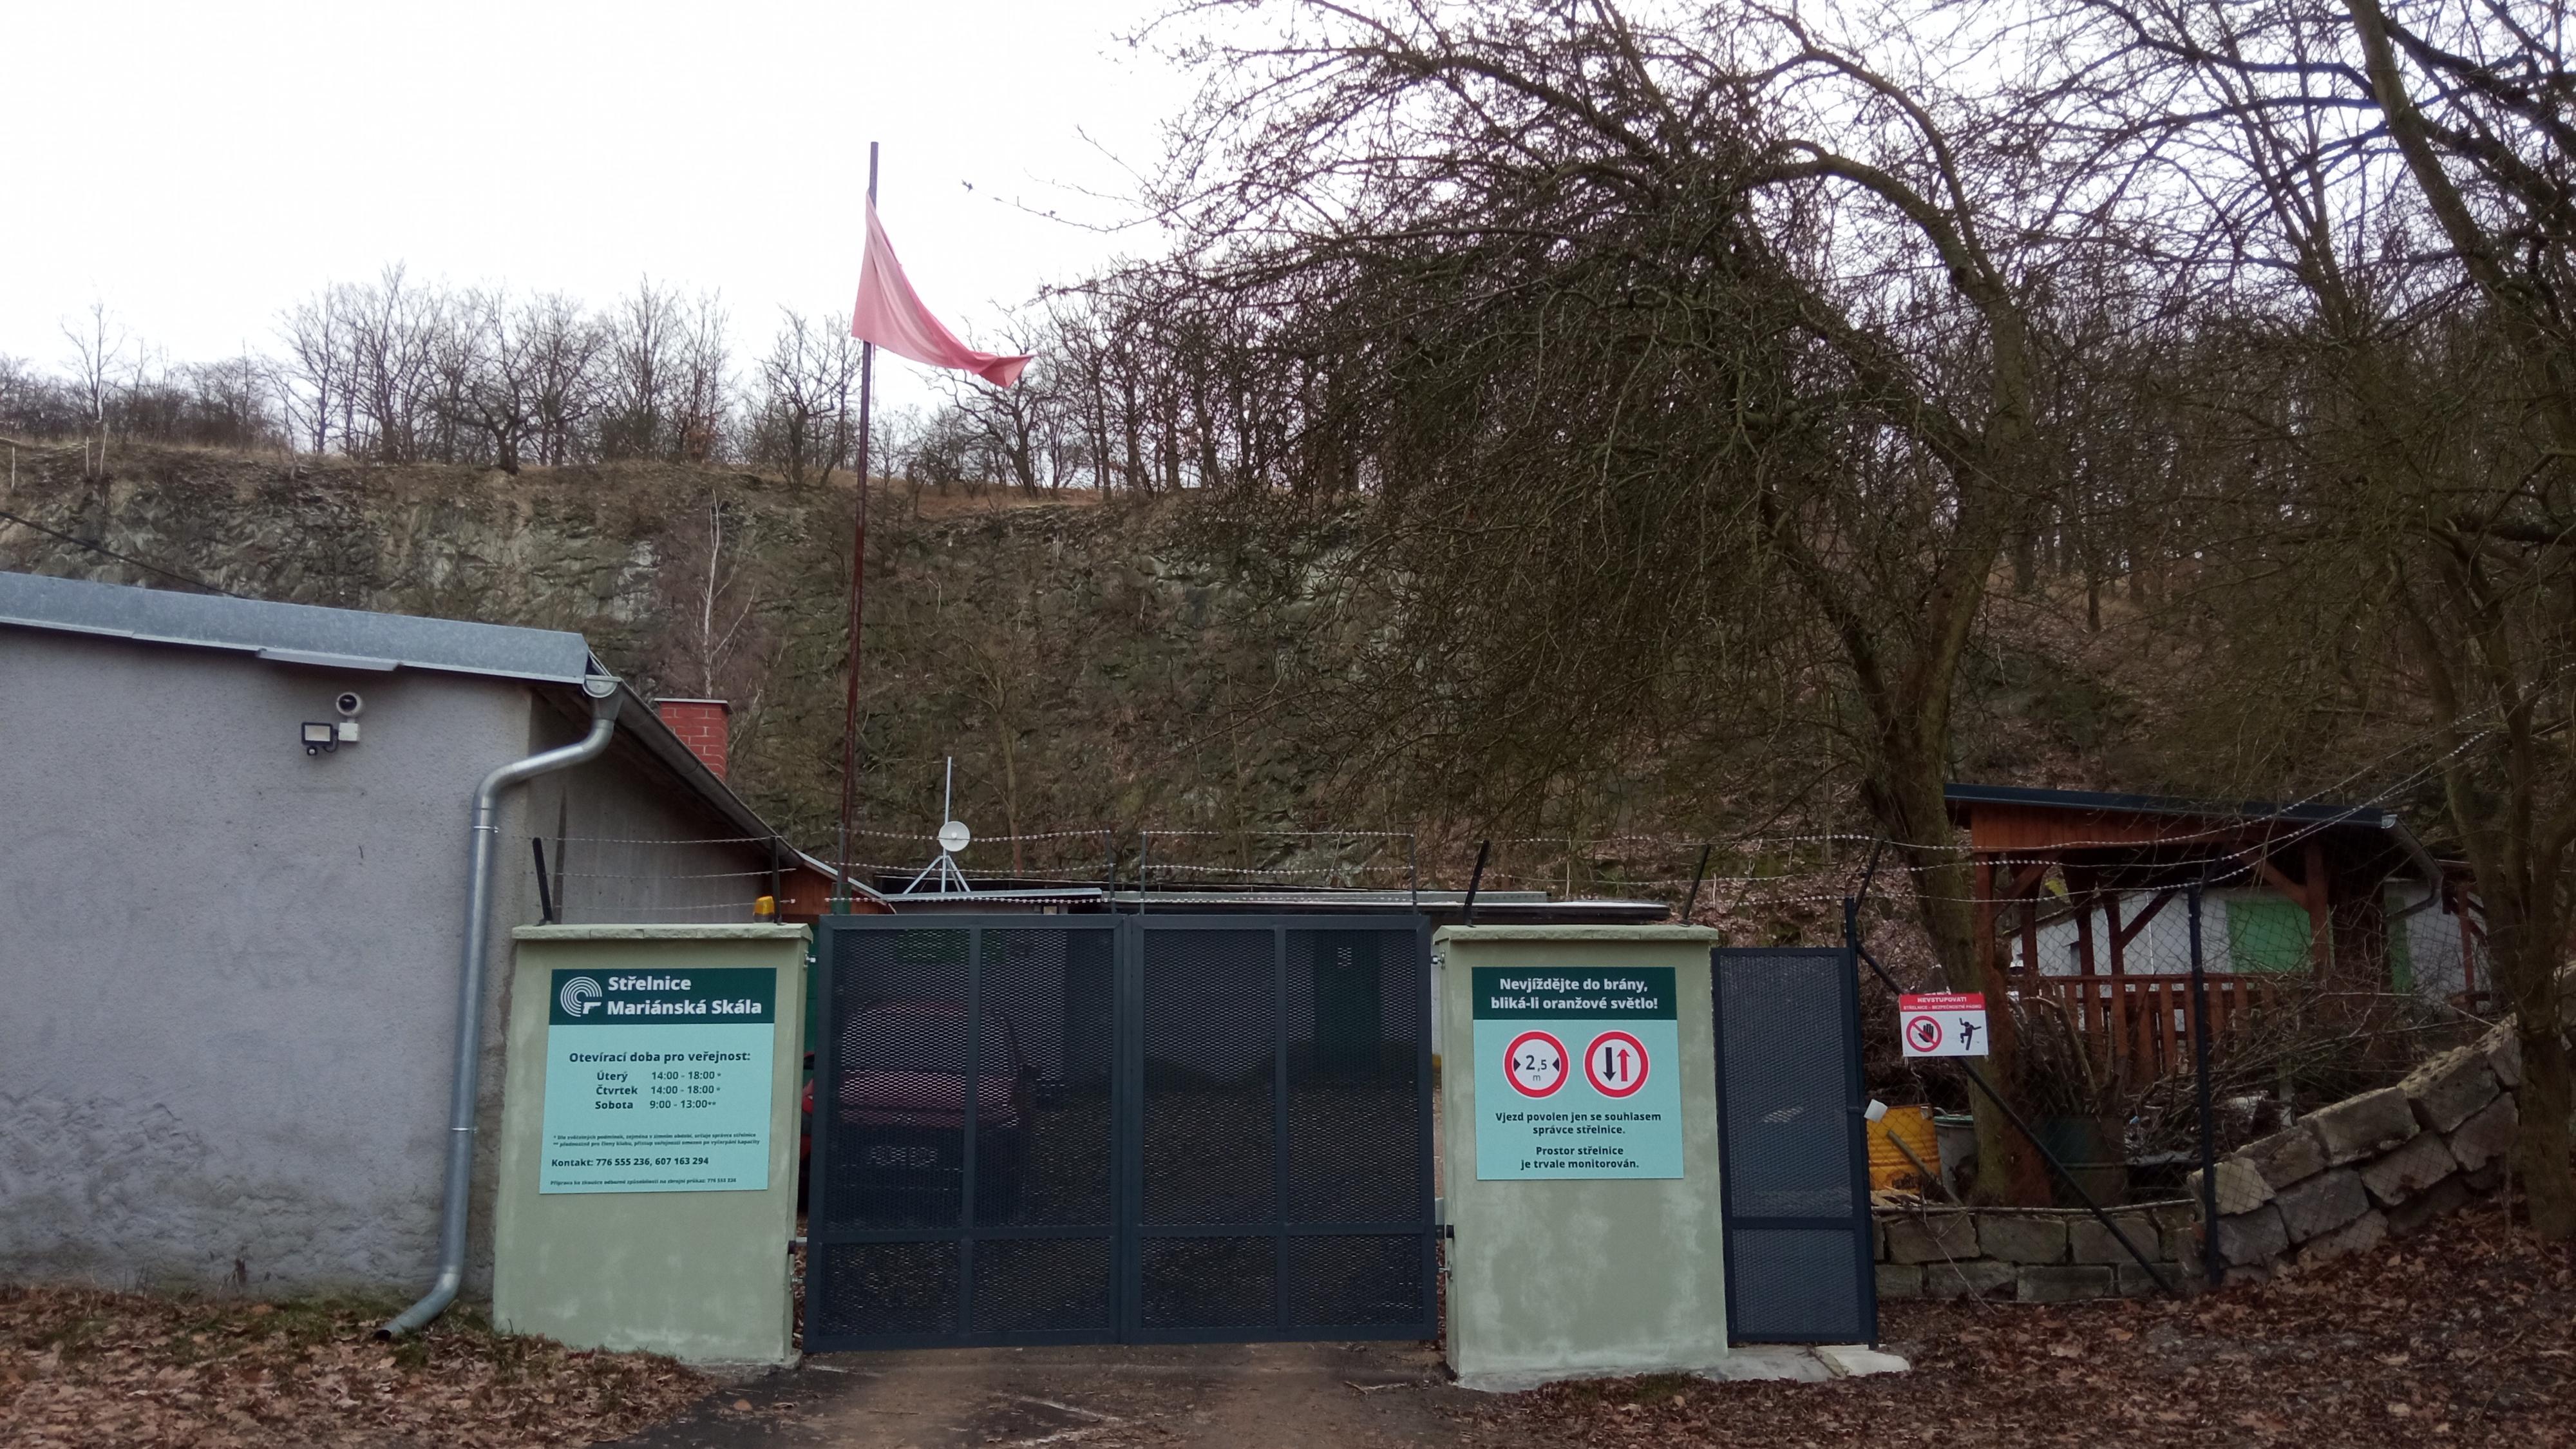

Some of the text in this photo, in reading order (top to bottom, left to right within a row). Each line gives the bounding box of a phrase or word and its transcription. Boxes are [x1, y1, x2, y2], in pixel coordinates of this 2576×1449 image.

[608, 976, 692, 991] Střelnice
[1500, 978, 1649, 993] Nevjíždějte do brány,
[607, 998, 762, 1016] Mariánská Skála
[1491, 997, 1659, 1010] bliká-li oranžové světlo!
[569, 1050, 752, 1065] Otevírací doba pro veřejnost:
[597, 1070, 628, 1082] Úterý
[652, 1071, 679, 1079] 14:00
[688, 1071, 715, 1079] 18:00
[1532, 1074, 1542, 1082] m
[596, 1085, 638, 1095] Čtvrtek
[650, 1085, 678, 1094] 14:00
[687, 1085, 714, 1094] 18:00
[595, 1101, 634, 1110] Sobota
[649, 1100, 671, 1109] 9:00
[1495, 1112, 1662, 1124] Vjezd povolen jen se souhlasem
[1532, 1124, 1627, 1136] správce střelnice.
[1535, 1145, 1624, 1157] Prostor střelnice
[551, 1159, 594, 1167] Kontakt:
[633, 1158, 652, 1167] 236,
[654, 1157, 672, 1166] 607
[1520, 1159, 1640, 1171] je trvale monitorován.
